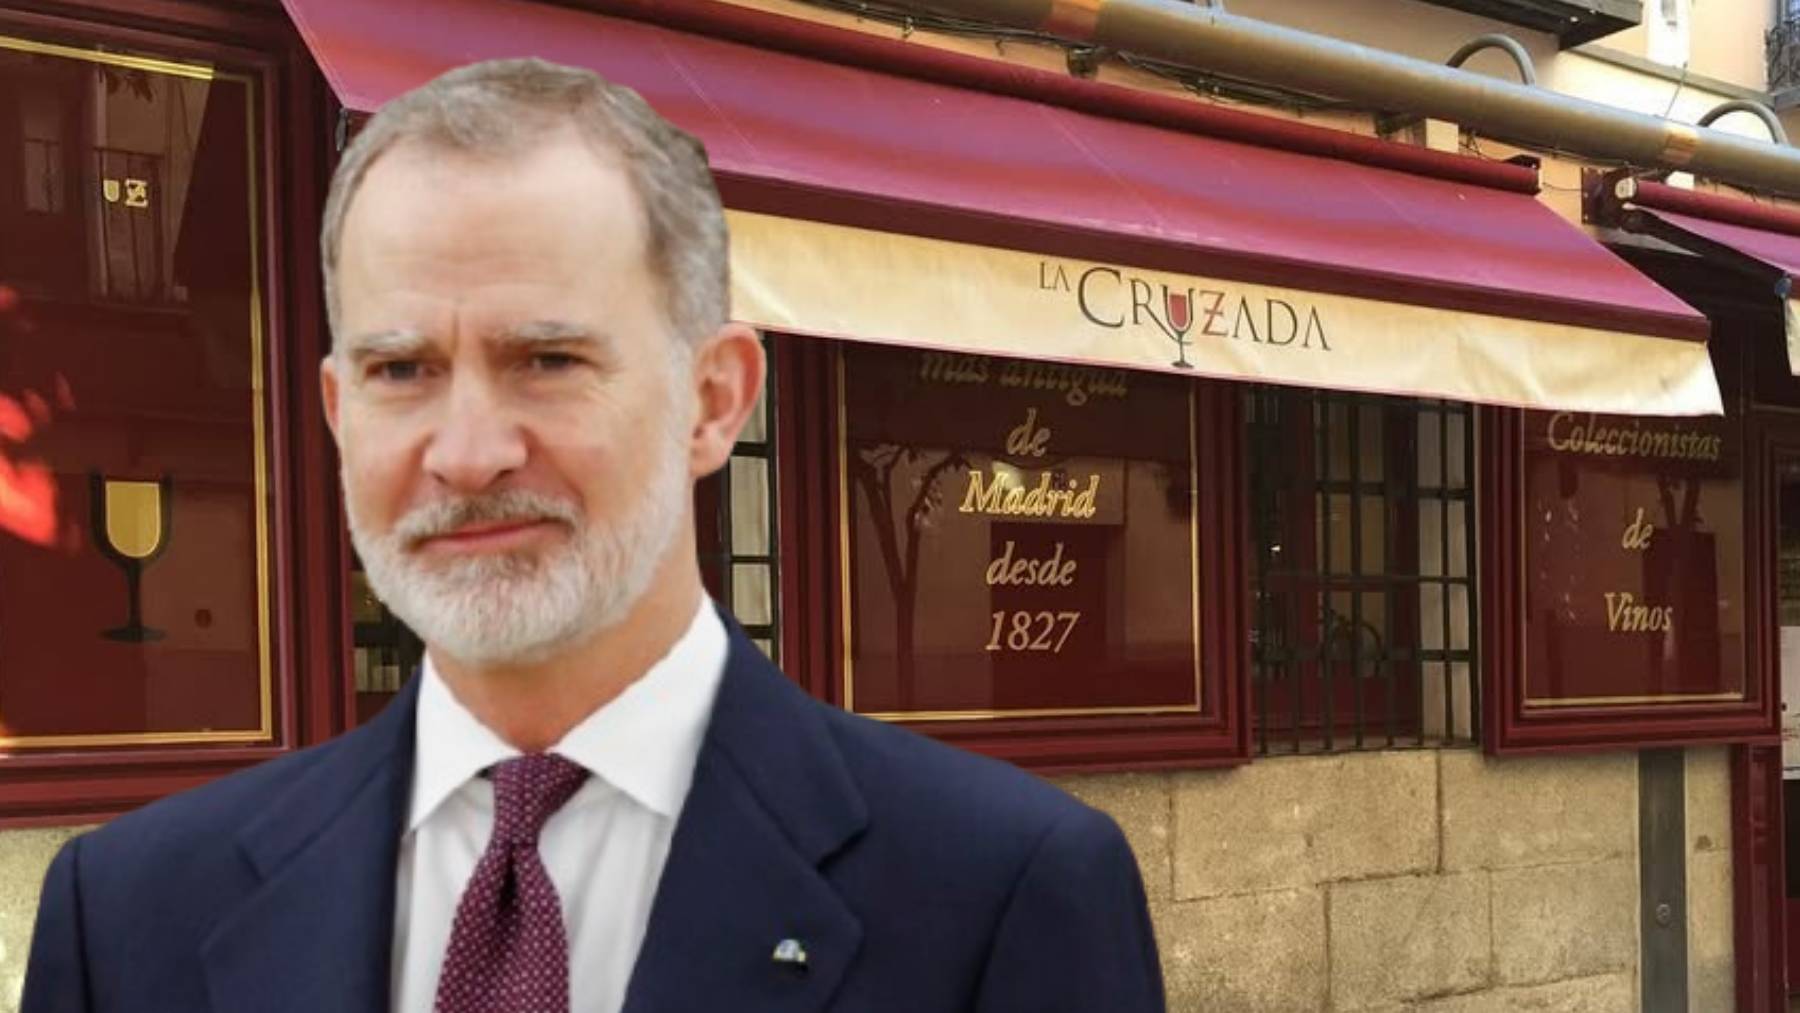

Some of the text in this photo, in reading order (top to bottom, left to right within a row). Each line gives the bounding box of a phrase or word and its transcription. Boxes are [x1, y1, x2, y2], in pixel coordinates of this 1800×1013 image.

[1039, 261, 1332, 368] LA CRUZADA
[1007, 407, 1050, 456] de
[1548, 411, 1721, 460] Coleccionistas
[959, 470, 1100, 519] Madrid
[1622, 507, 1653, 549] de
[986, 540, 1077, 585] desde
[985, 610, 1081, 653] 1827
[1604, 592, 1673, 632] Vinos
